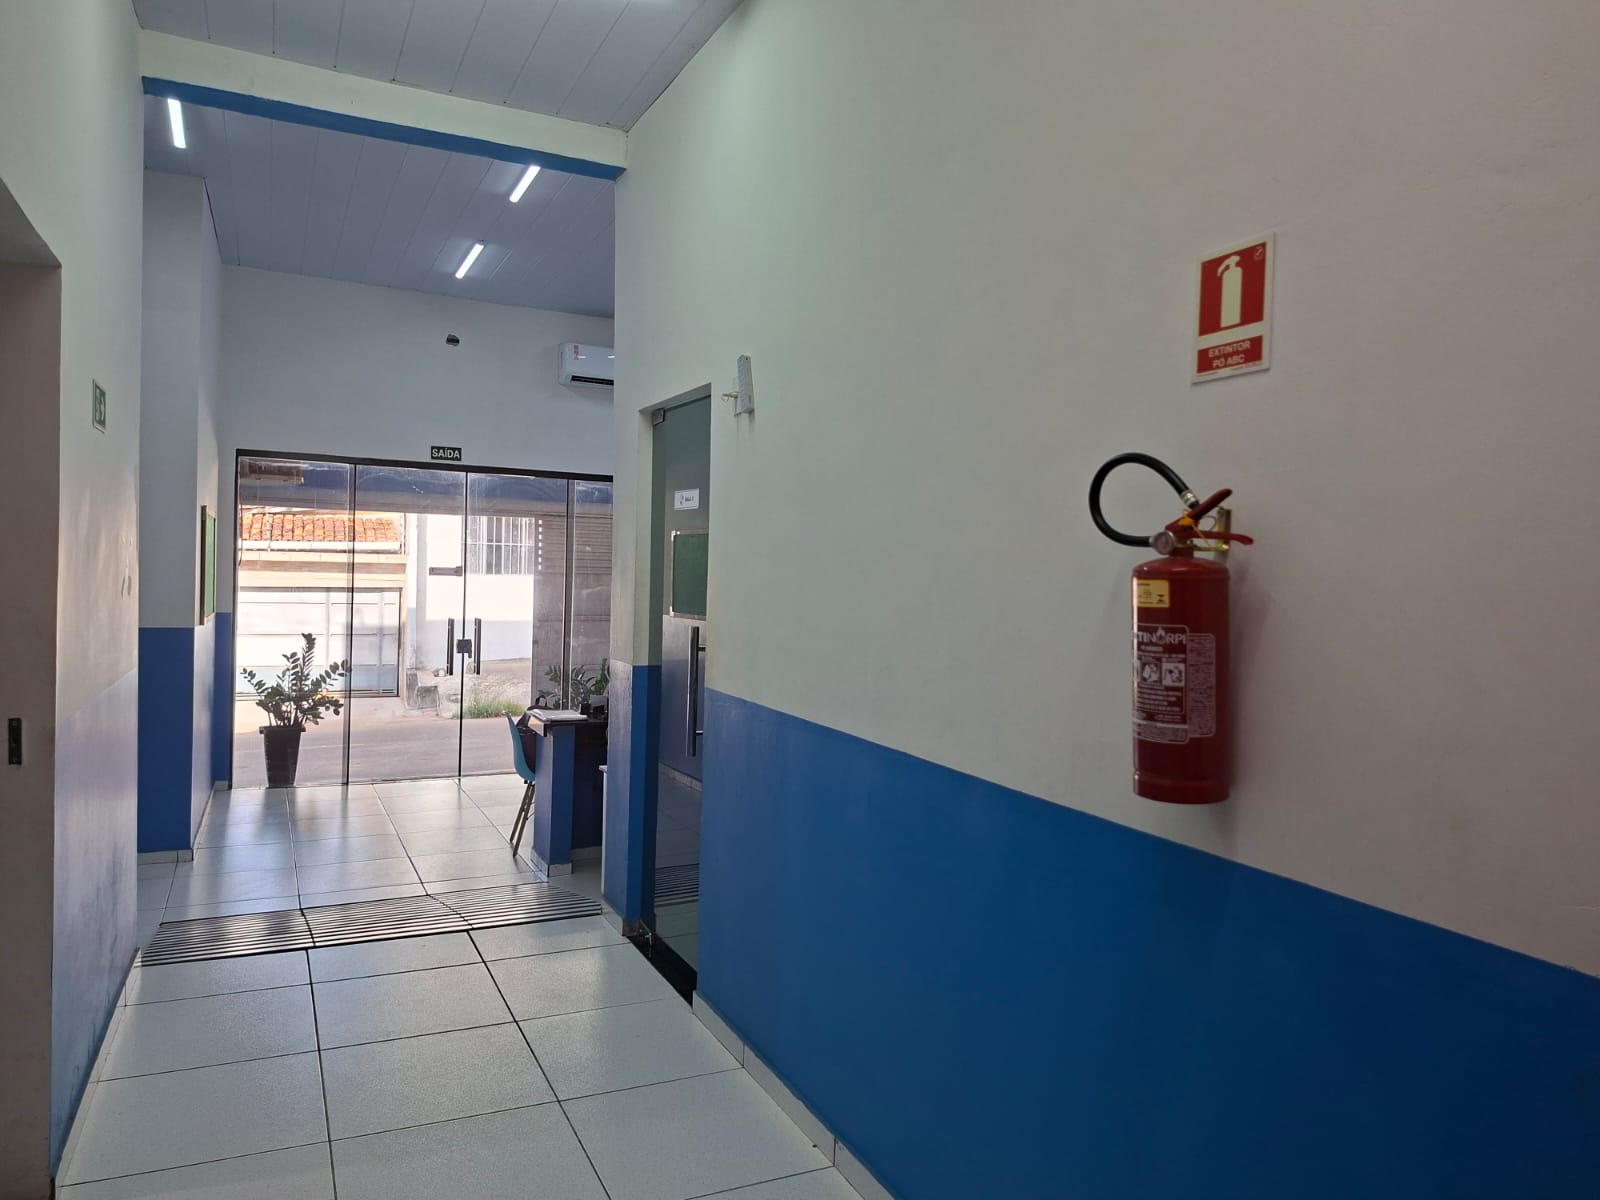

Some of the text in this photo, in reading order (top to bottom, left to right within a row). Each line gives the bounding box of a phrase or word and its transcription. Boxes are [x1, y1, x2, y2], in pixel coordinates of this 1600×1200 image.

[1208, 340, 1251, 358] EXTINTOR
[1226, 354, 1245, 366] ABC
[432, 447, 460, 459] SAÍDA
[1134, 626, 1186, 645] TINORPI
